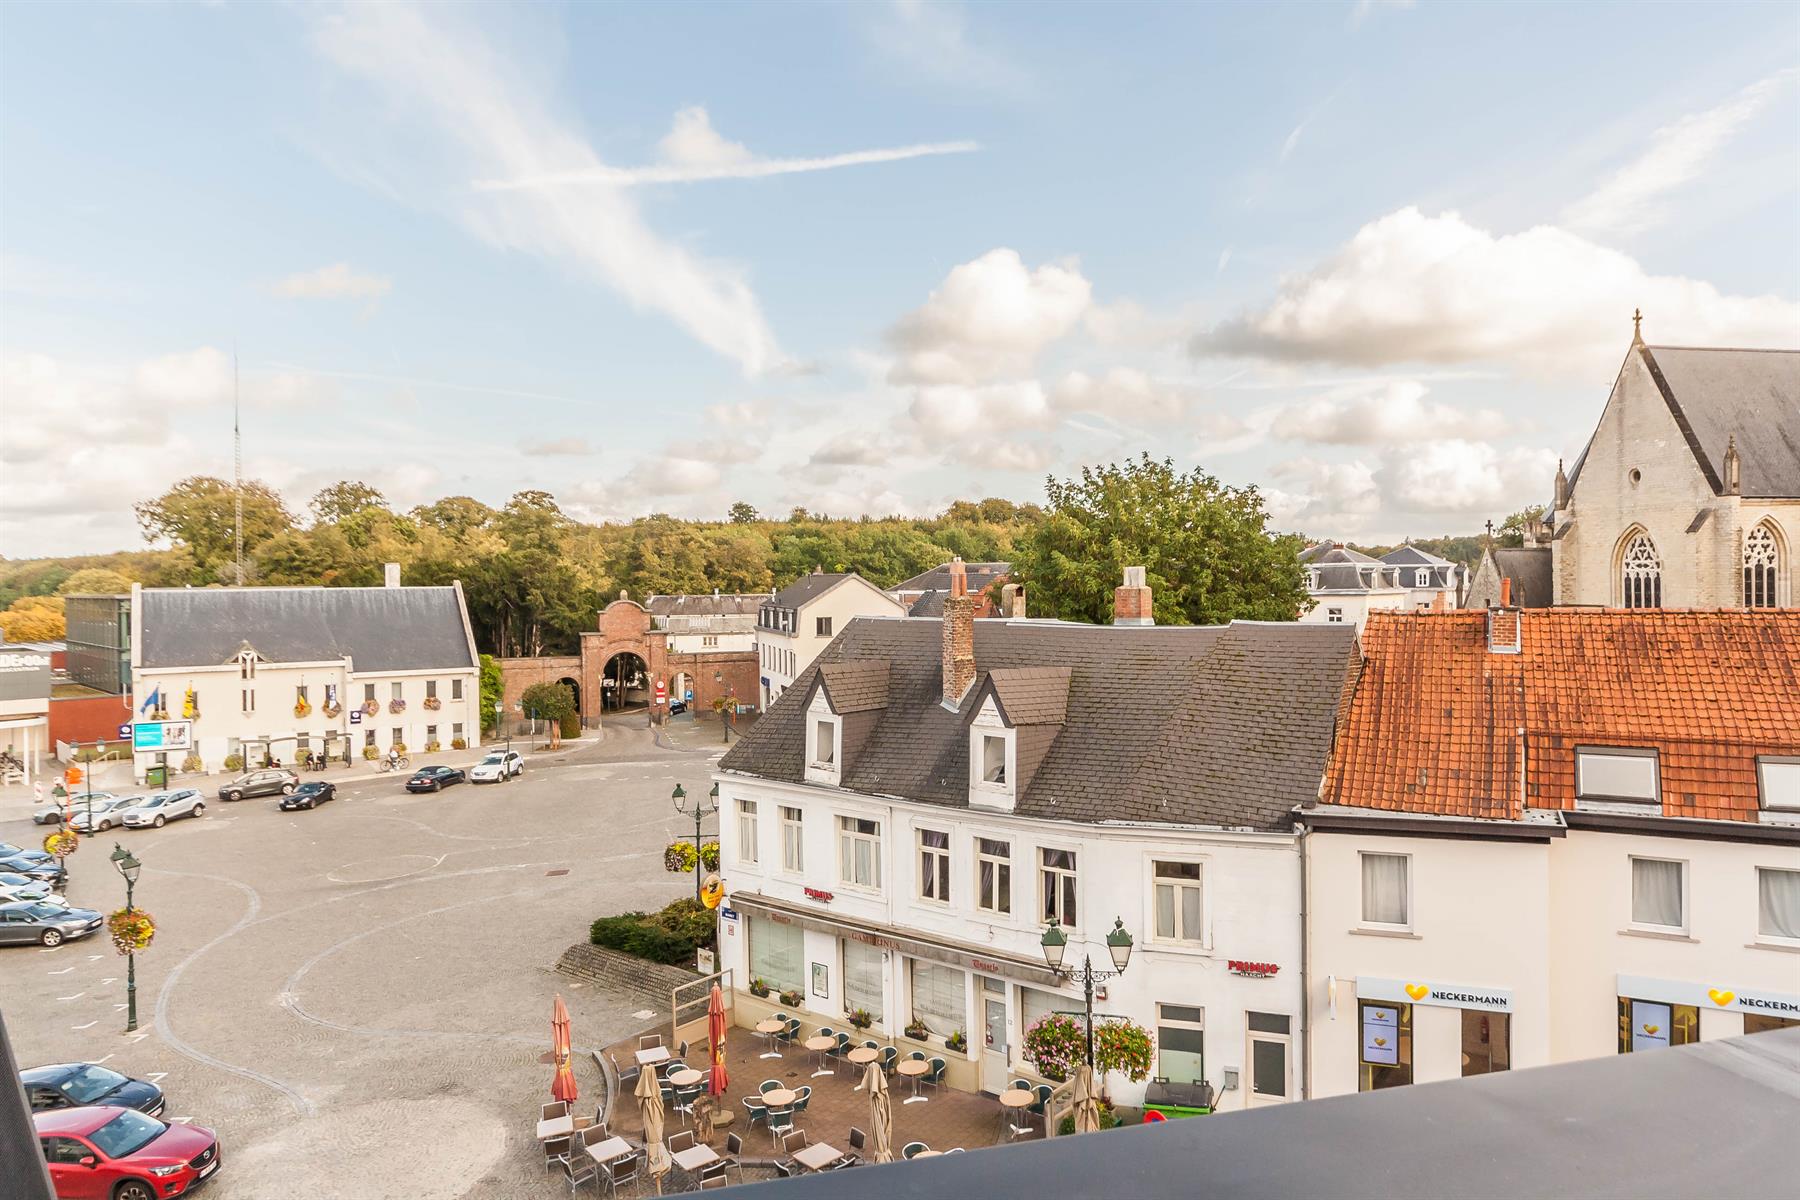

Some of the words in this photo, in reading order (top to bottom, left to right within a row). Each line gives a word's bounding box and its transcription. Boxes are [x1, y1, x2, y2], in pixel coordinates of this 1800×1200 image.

[1228, 960, 1278, 974] PRIMUS
[1432, 991, 1507, 1006] NECKERMANN
[1739, 997, 1800, 1012] NECKERM
